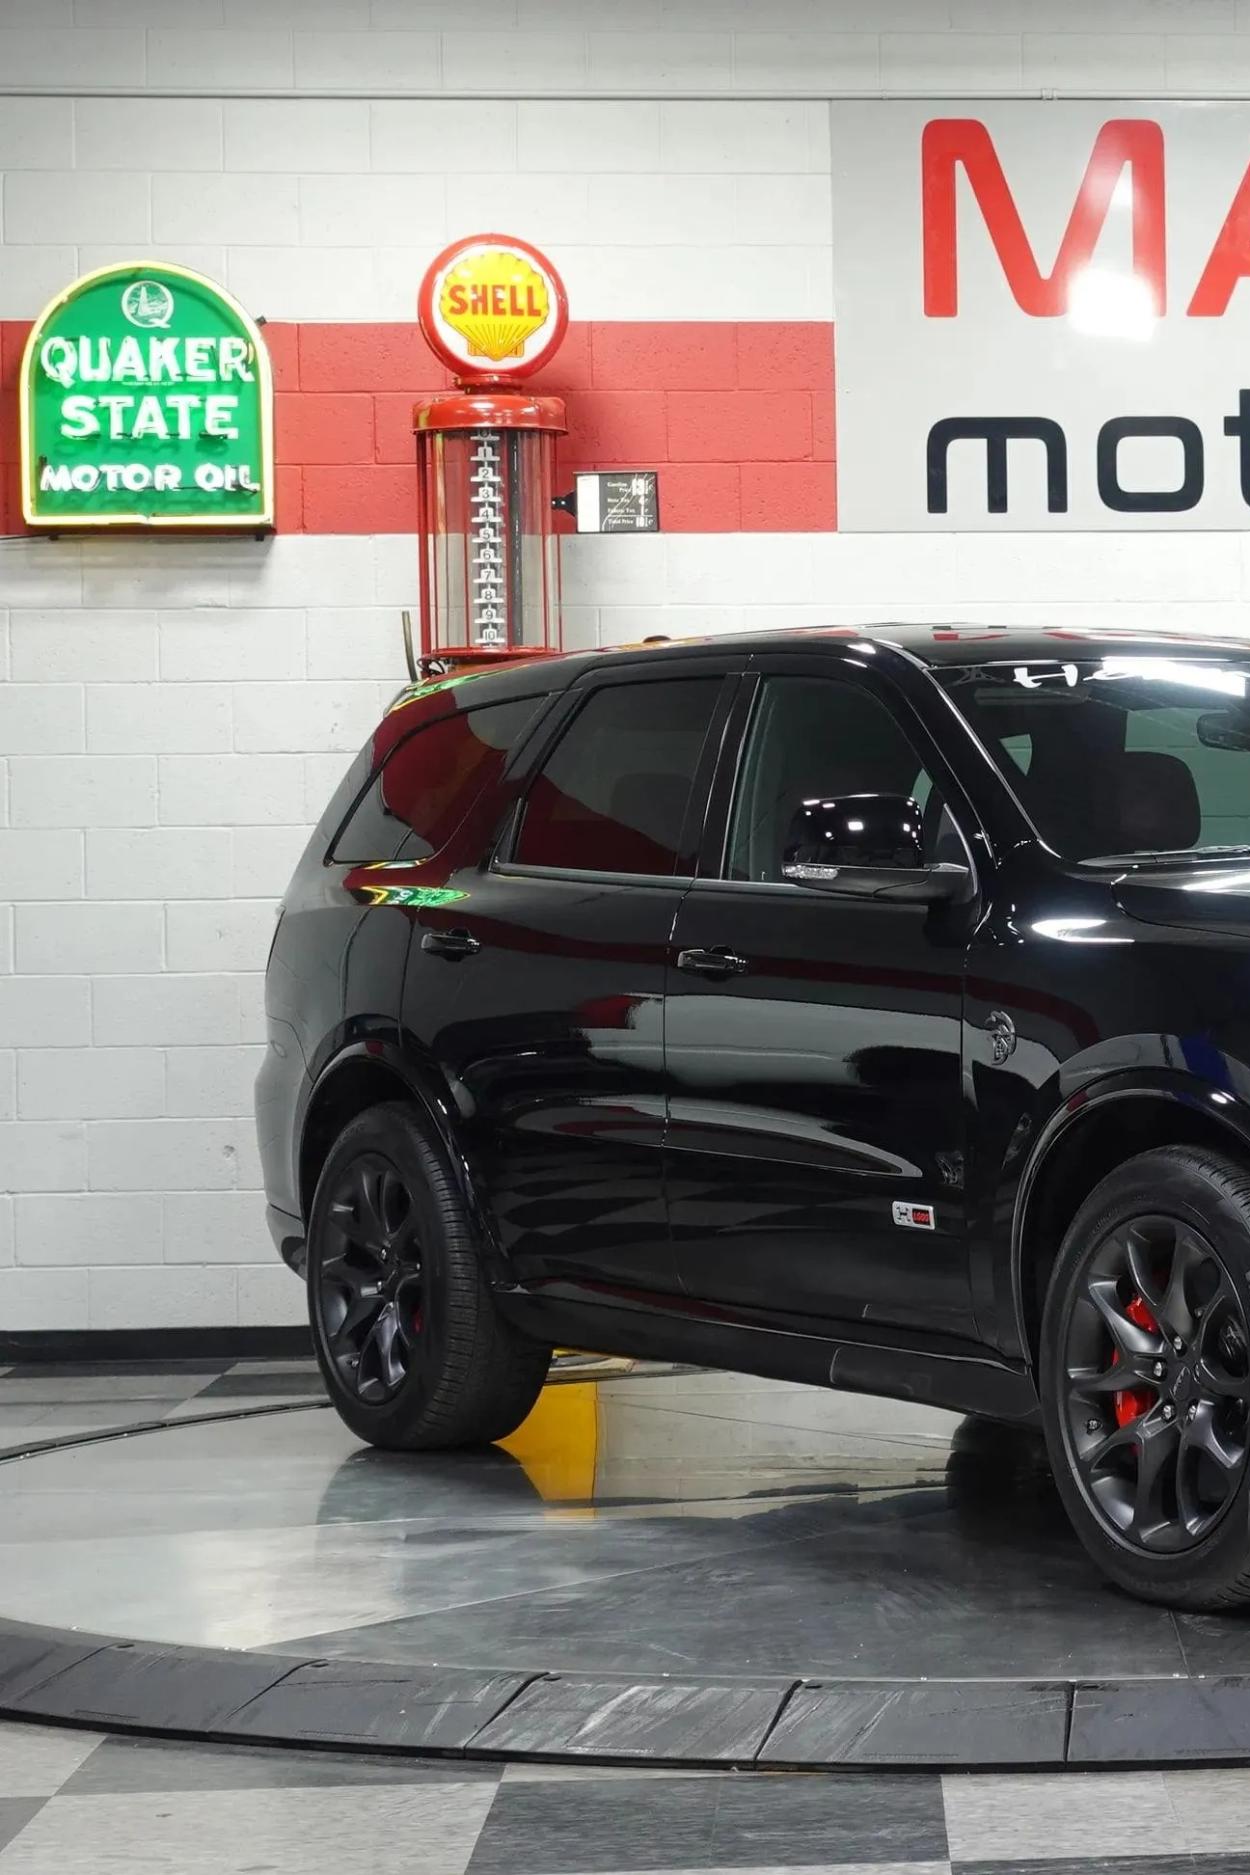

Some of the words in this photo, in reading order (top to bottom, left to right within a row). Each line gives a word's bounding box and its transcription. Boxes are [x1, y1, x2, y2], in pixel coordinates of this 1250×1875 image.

[448, 284, 542, 317] SHELL
[40, 335, 256, 389] QUAKER
[60, 395, 239, 440] STATE
[40, 463, 182, 492] MOTOR
[194, 463, 261, 492] OIL
